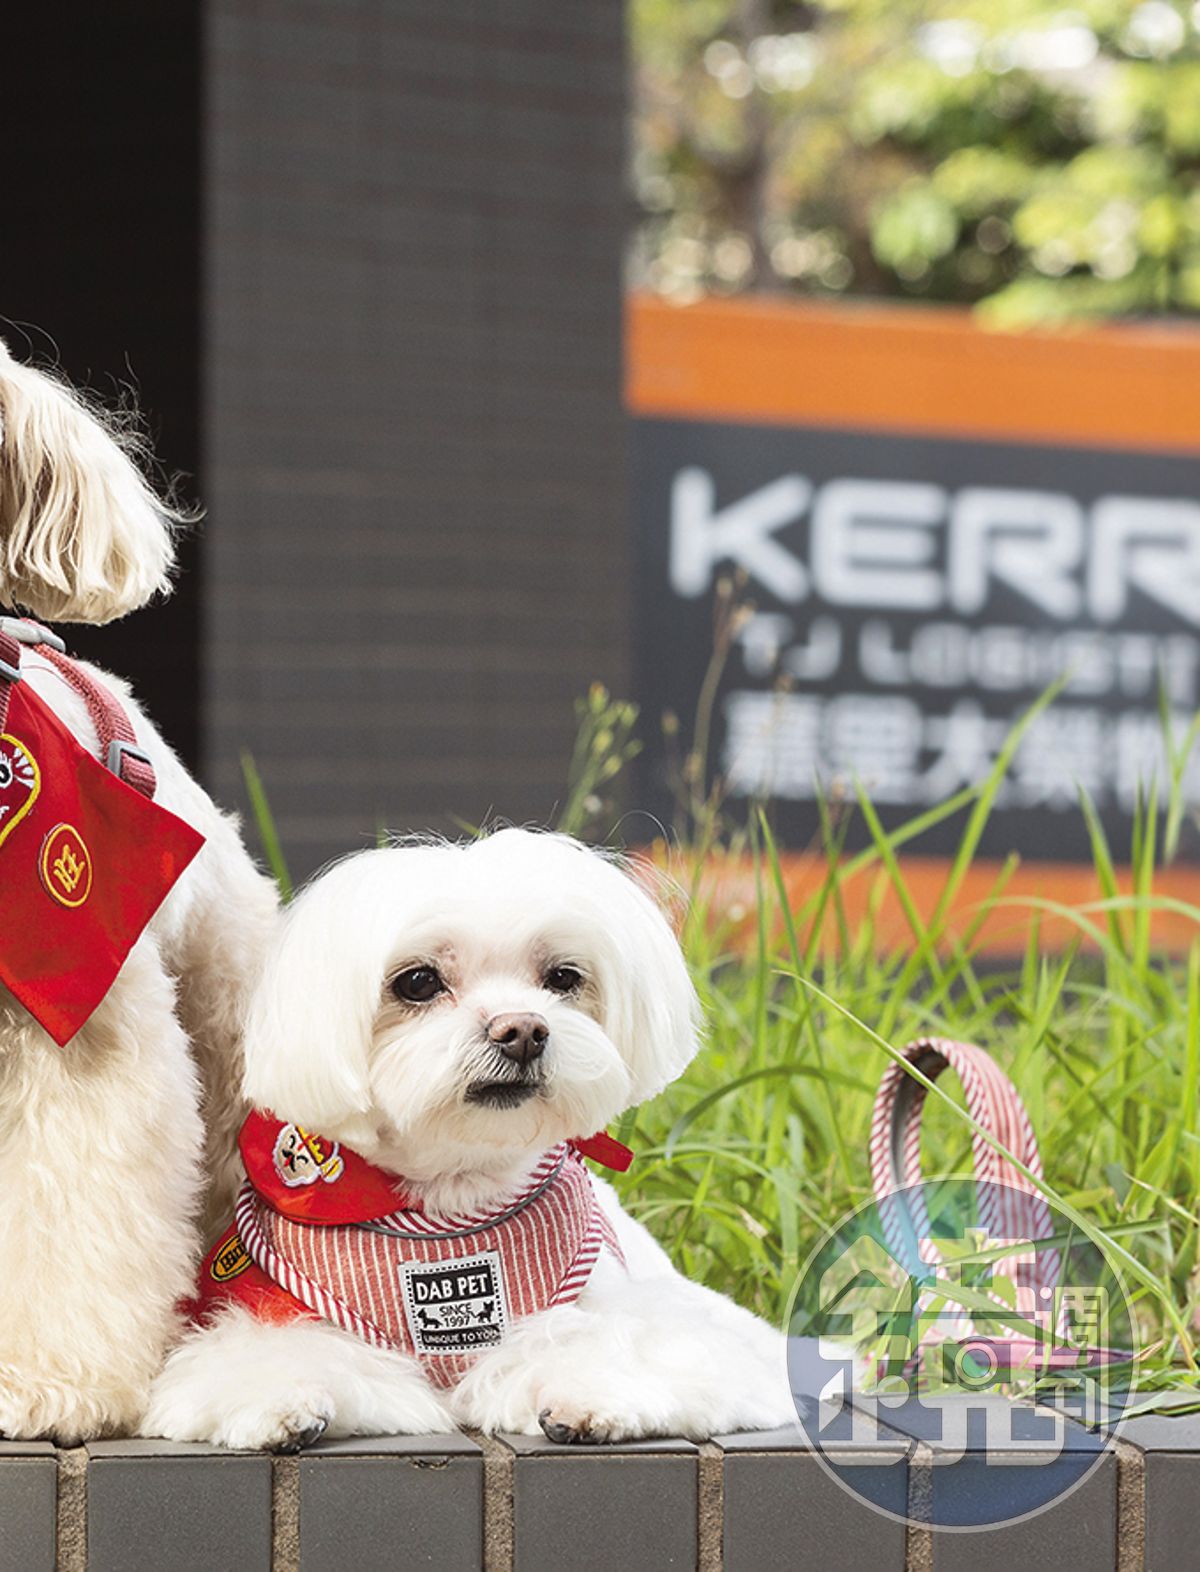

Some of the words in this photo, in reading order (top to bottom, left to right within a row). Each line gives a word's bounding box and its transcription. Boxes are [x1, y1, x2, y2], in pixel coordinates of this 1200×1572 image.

[669, 464, 1200, 632] KERR
[415, 1279, 453, 1301] DAB
[456, 1273, 488, 1296] PET
[439, 1302, 473, 1317] SINCE
[444, 1315, 471, 1328] 1997
[461, 1332, 476, 1342] TO
